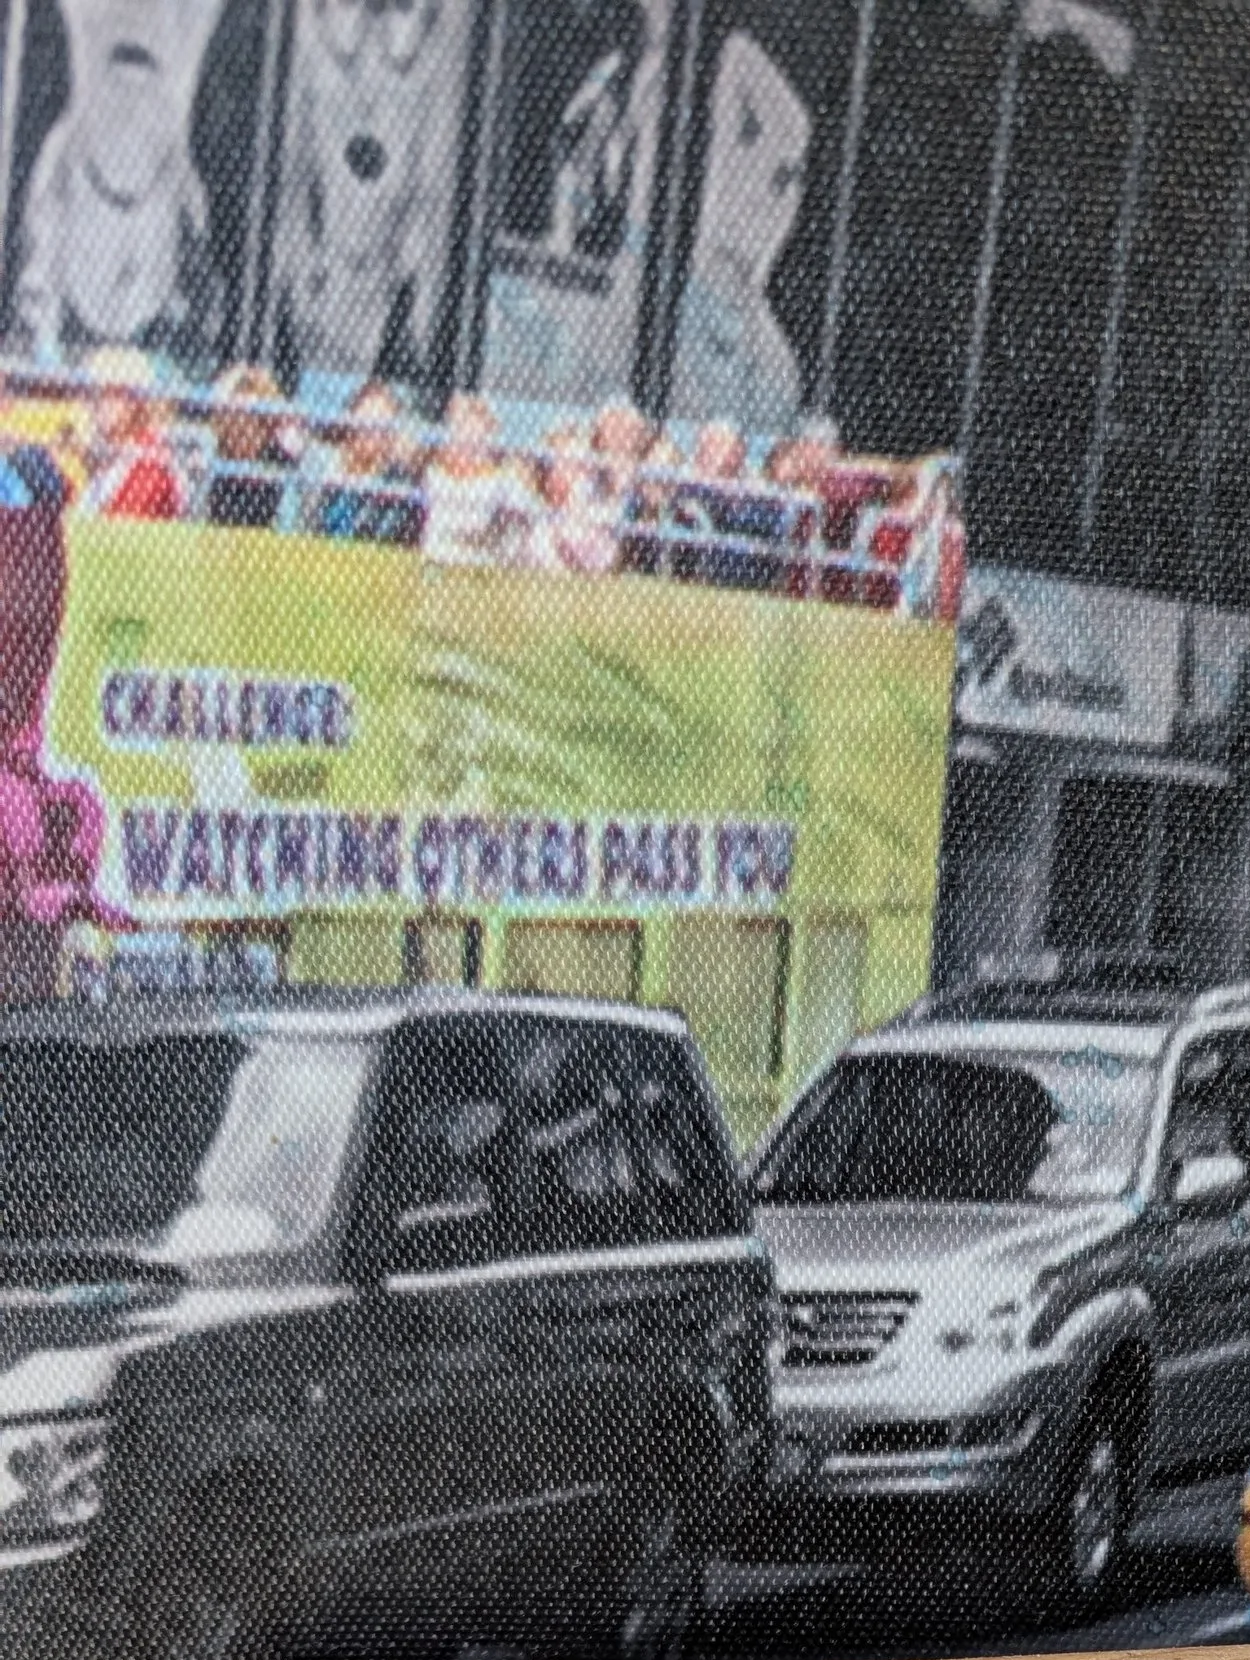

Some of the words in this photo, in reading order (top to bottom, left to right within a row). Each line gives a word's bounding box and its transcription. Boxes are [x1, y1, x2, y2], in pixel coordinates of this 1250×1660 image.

[121, 808, 401, 895] WATCHING
[413, 814, 588, 899] OTHERS
[602, 820, 701, 896] PASS
[714, 823, 797, 896] YOU
